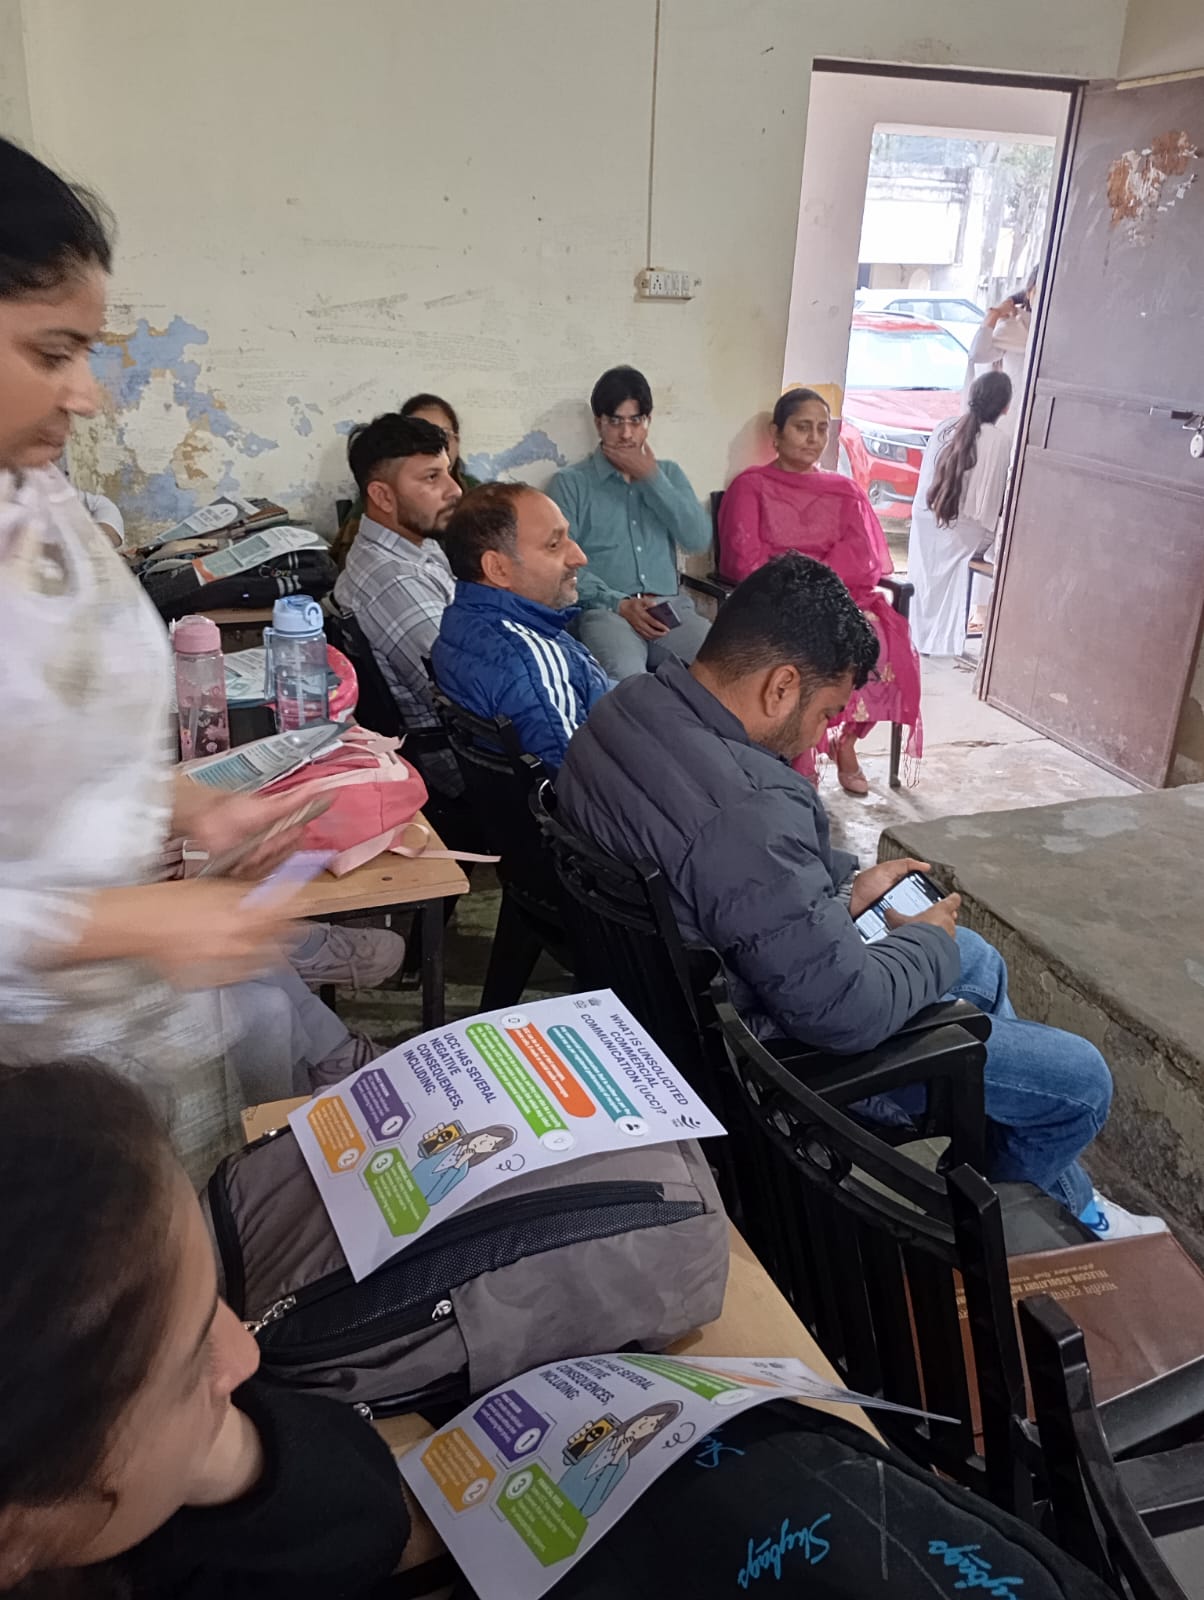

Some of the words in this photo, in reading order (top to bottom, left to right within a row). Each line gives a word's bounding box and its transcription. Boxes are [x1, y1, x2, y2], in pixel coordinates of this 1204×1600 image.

[430, 1038, 461, 1075] NEGATIVE
[444, 1033, 460, 1049] UCC
[455, 1049, 472, 1066] HAS
[466, 1067, 496, 1104] SEVERAL
[581, 1014, 642, 1082] COMMUNICATION
[635, 1085, 667, 1114] (UCC)?
[610, 1014, 634, 1035] WHAT
[629, 1038, 642, 1046] IS
[638, 1048, 688, 1104] UNSOLICITED
[610, 1032, 657, 1088] COMMERCIAL
[403, 1050, 436, 1095] INCLUDING:
[417, 1044, 463, 1110] CONSEQUENCES,
[387, 1121, 398, 1130] 1
[343, 1153, 354, 1164] 2
[376, 1158, 388, 1169] 3
[1023, 1276, 1073, 1291] REGULATORY
[1072, 1269, 1109, 1283] TELECOM
[540, 1370, 579, 1400] INCLUDING:
[556, 1365, 614, 1405] CONSEQUENCES,
[618, 1370, 654, 1390] SEVERAL
[522, 1434, 534, 1447] 1
[468, 1485, 484, 1499] 2
[512, 1478, 526, 1493] 3
[738, 1513, 832, 1589] Skybags
